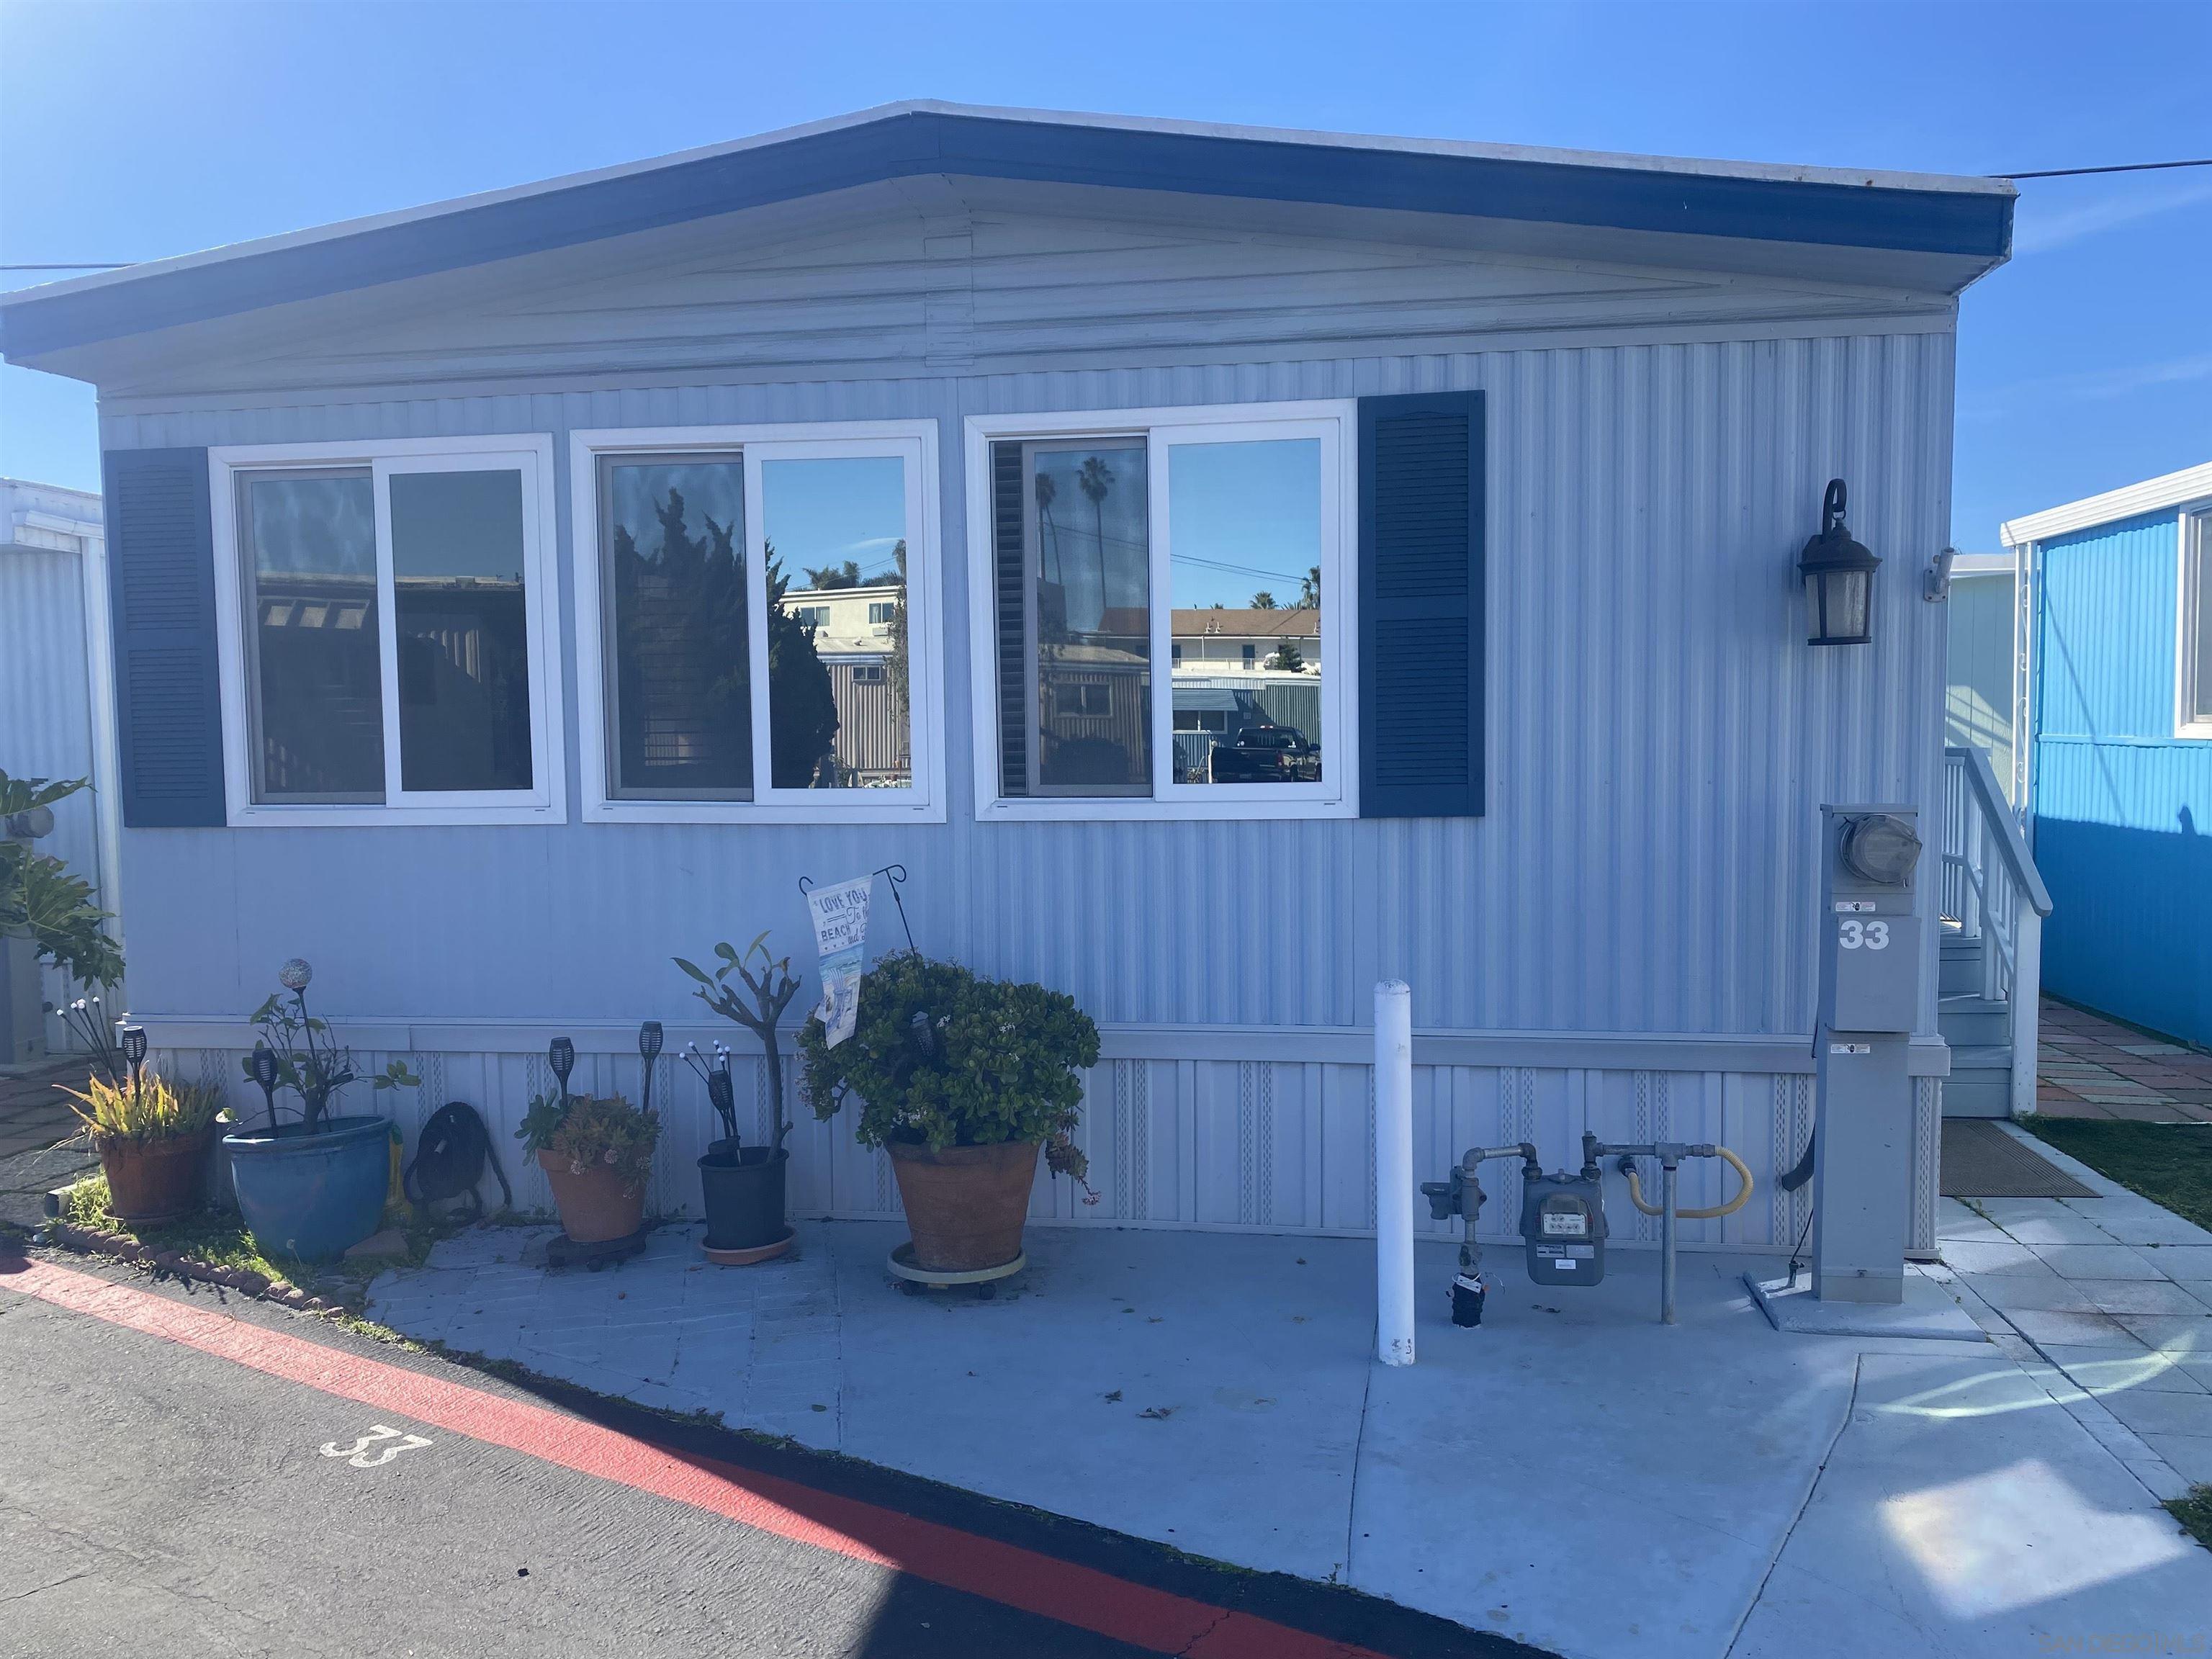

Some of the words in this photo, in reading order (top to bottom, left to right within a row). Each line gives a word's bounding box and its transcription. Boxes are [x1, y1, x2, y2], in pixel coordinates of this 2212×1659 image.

[819, 894, 845, 913] LOVE
[845, 887, 868, 906] YOU
[845, 907, 861, 925] To
[821, 924, 851, 942] BEACH
[1839, 920, 1890, 950] 33
[319, 1424, 433, 1467] 33
